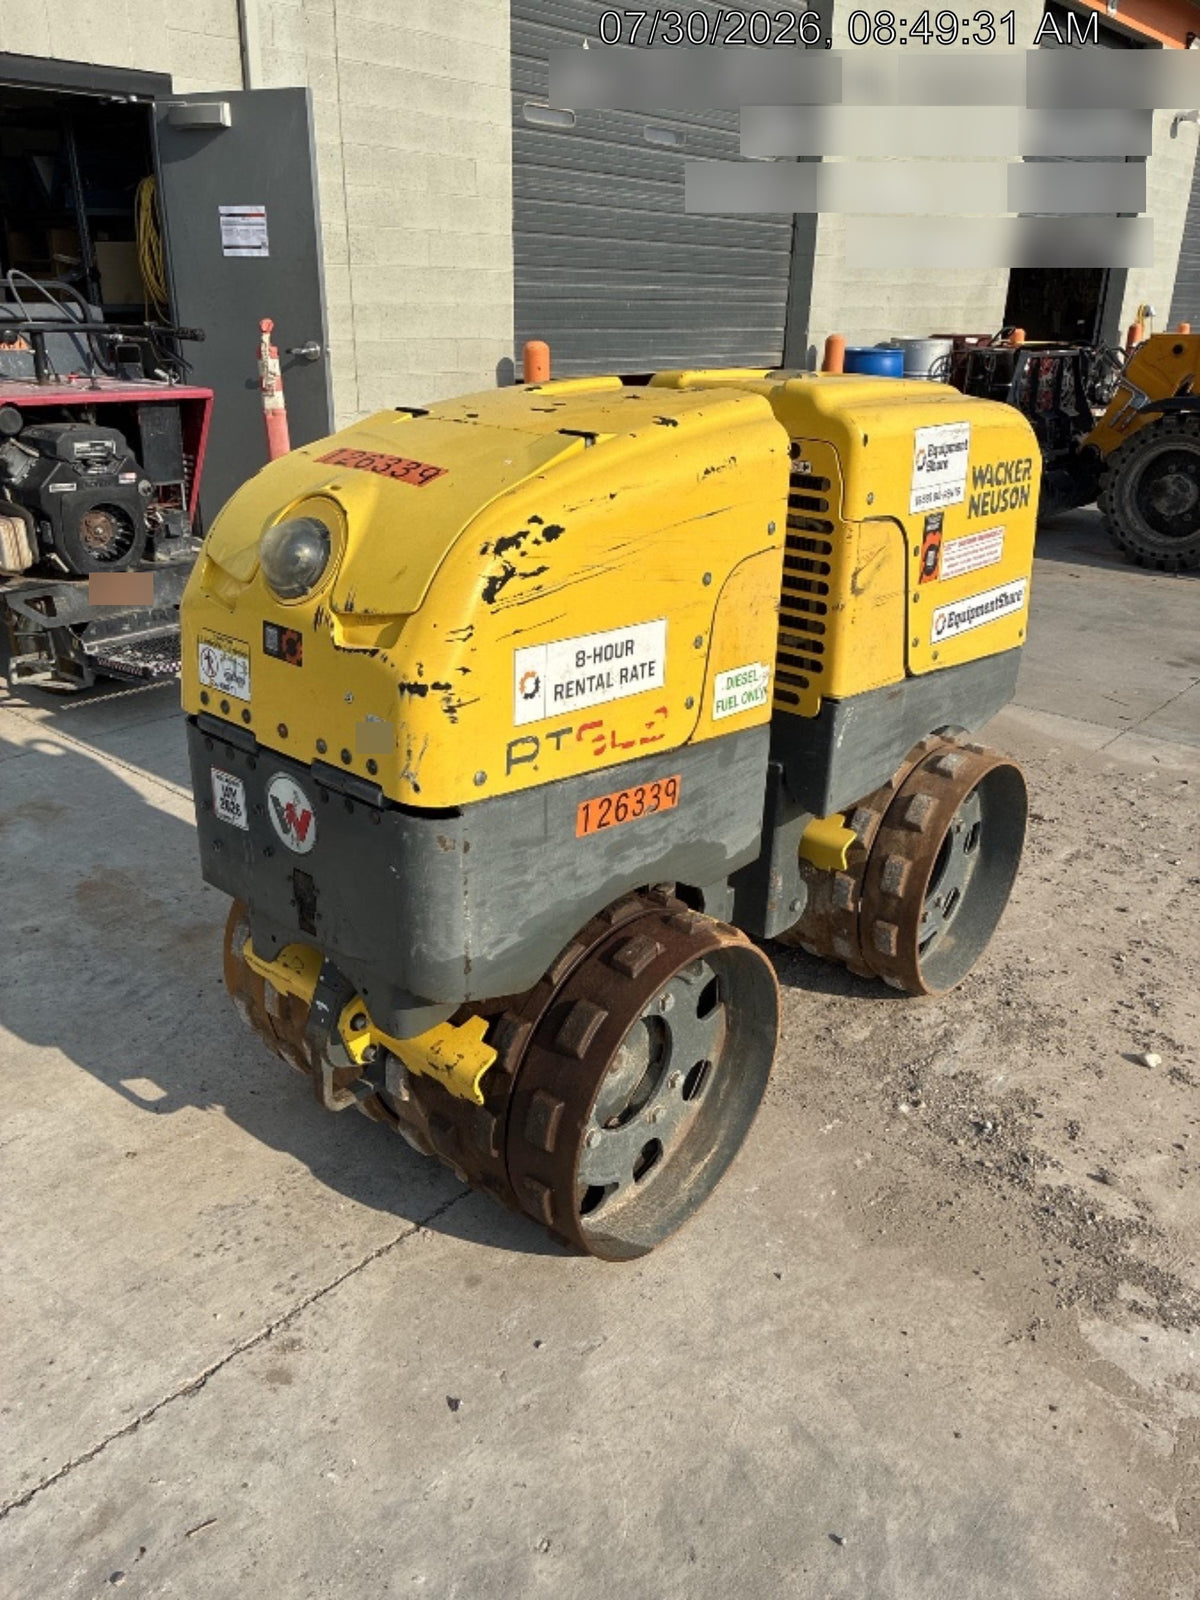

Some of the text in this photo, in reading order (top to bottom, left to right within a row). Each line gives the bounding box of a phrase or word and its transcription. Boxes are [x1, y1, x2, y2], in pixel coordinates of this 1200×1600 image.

[972, 458, 1032, 490] WACKER
[967, 483, 1031, 519] NEUSON
[946, 589, 1023, 629] EquipmentShare
[575, 639, 635, 668] 8-HOUR
[554, 660, 656, 701] RENTAL RATE
[726, 669, 759, 690] DIESEL
[716, 686, 767, 713] FUEL ONLY
[582, 778, 677, 832] 126339
